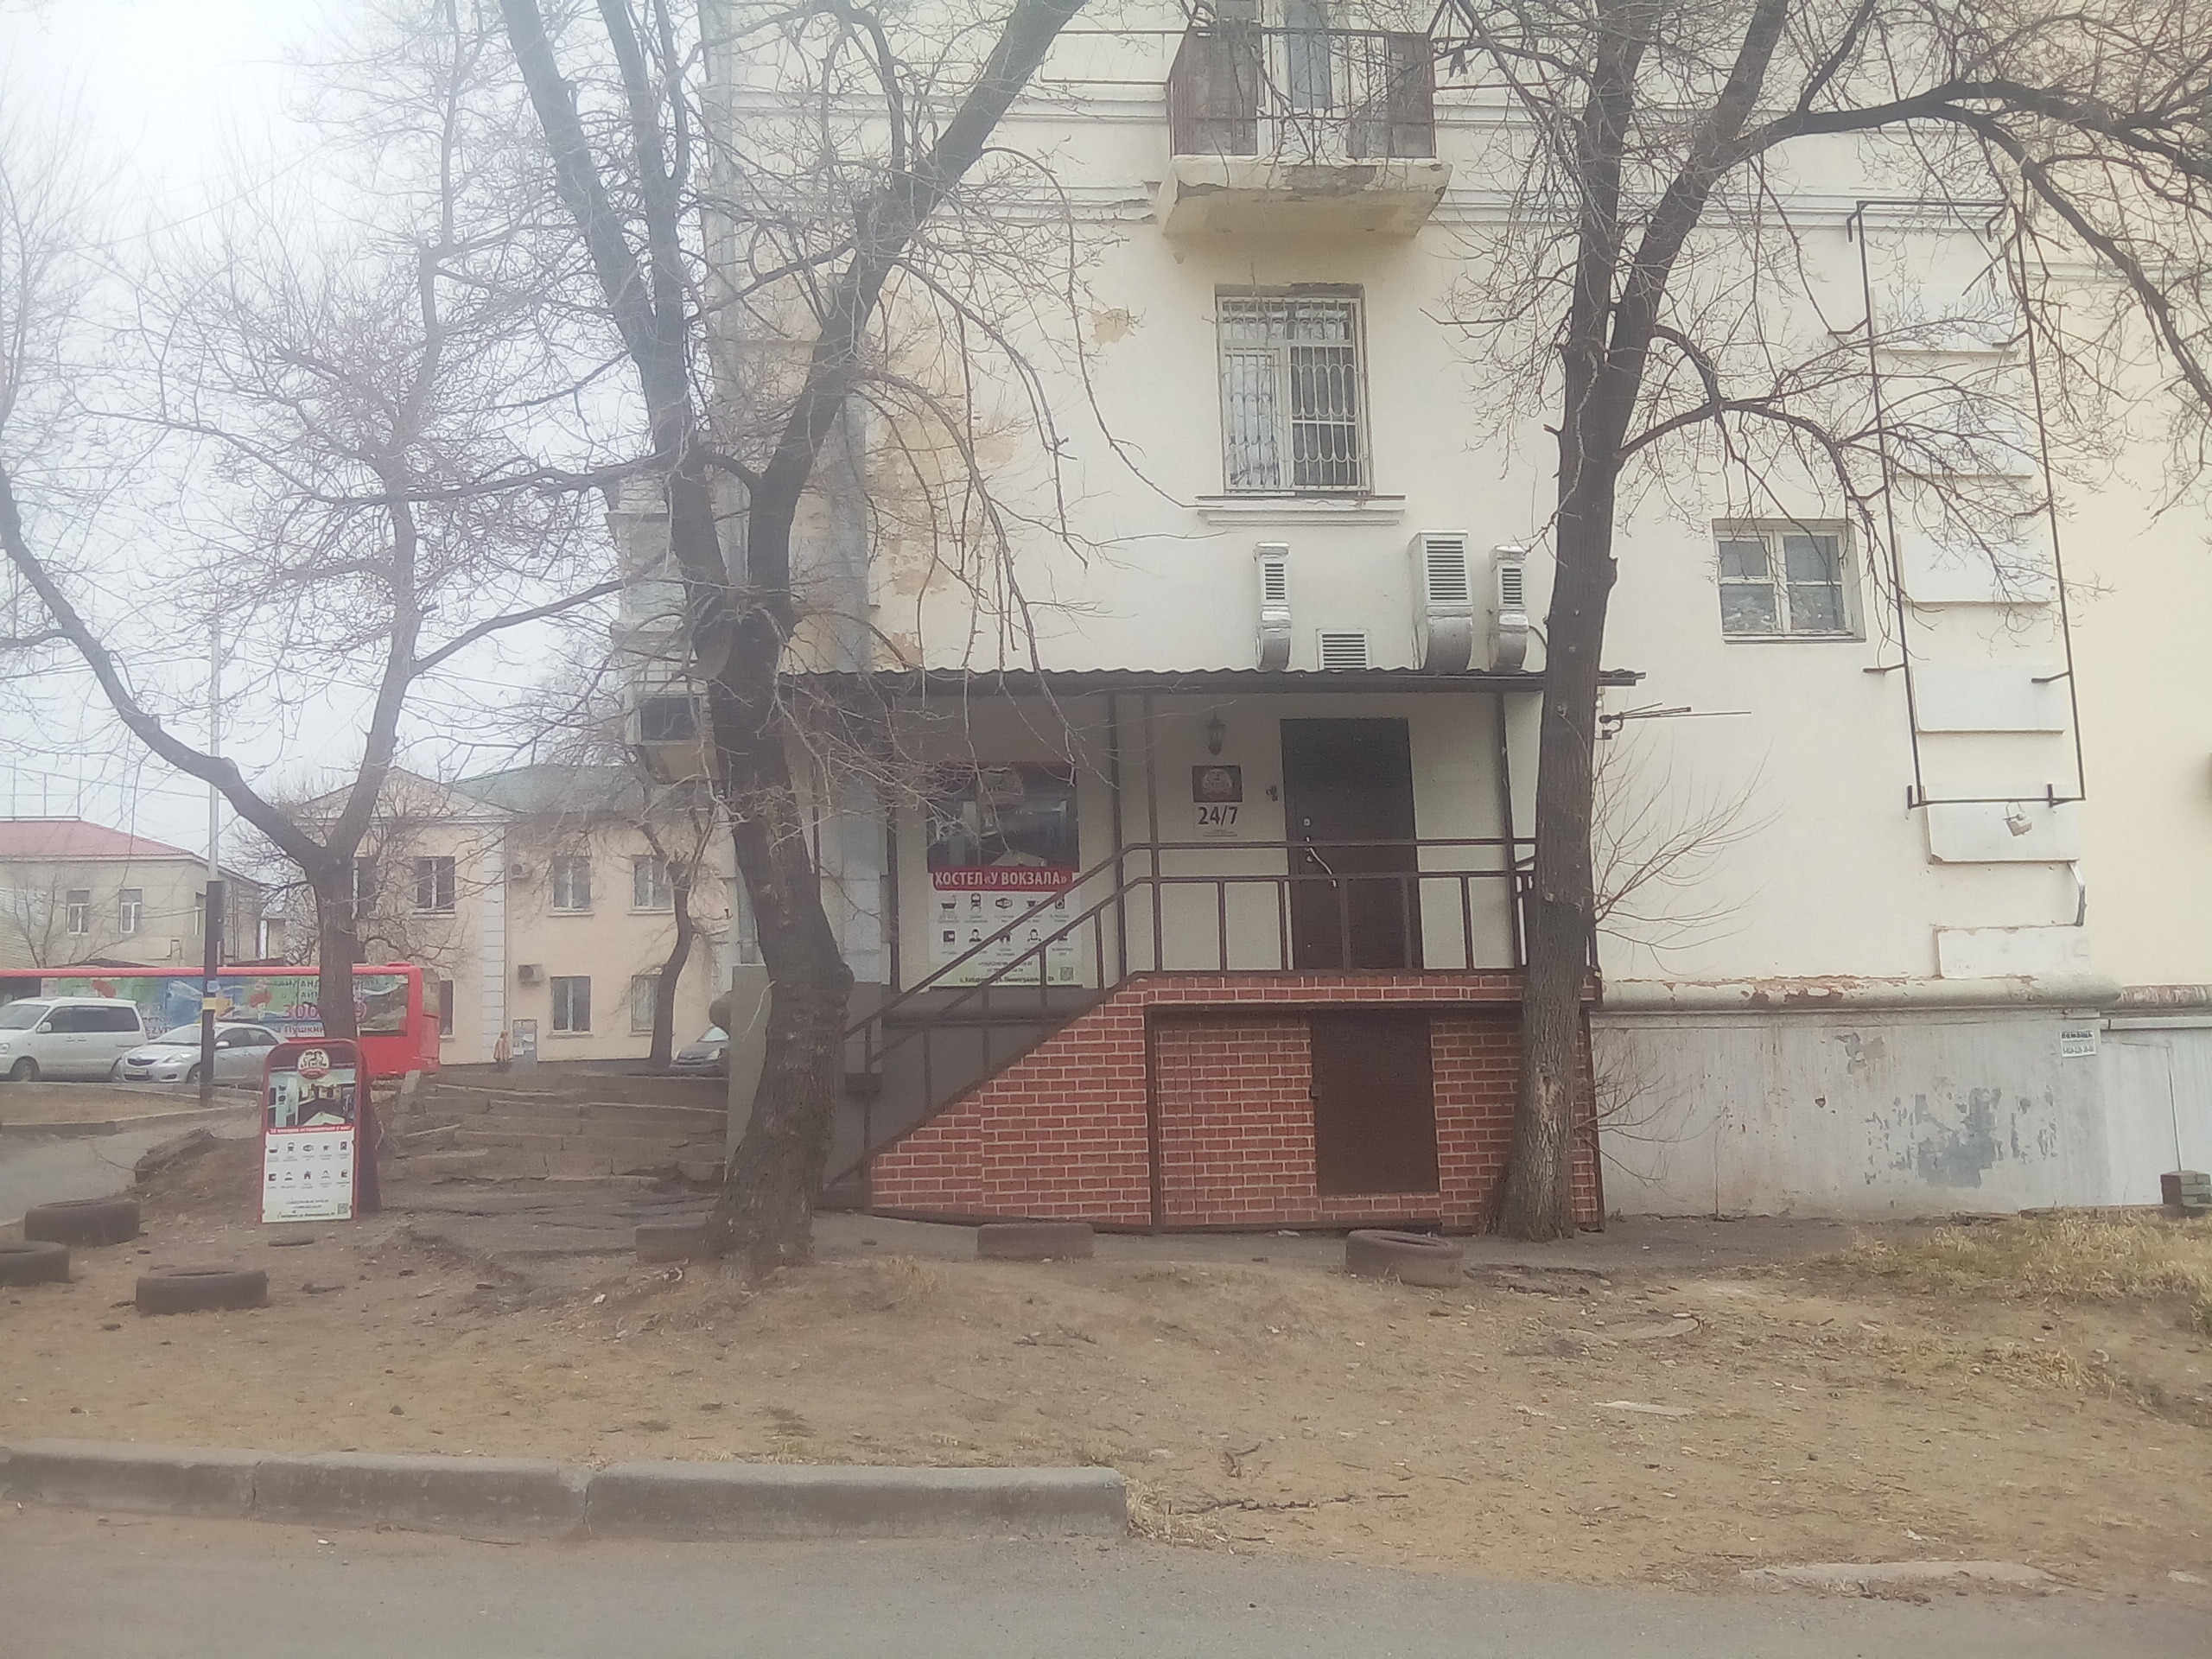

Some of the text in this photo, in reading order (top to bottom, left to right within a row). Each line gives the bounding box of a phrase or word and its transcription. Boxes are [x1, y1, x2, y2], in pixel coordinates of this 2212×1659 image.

[1198, 805, 1238, 827] 24/7
[935, 871, 982, 886] ХОСТЕЛ
[1001, 871, 1068, 886] ВОКЗАЛА»
